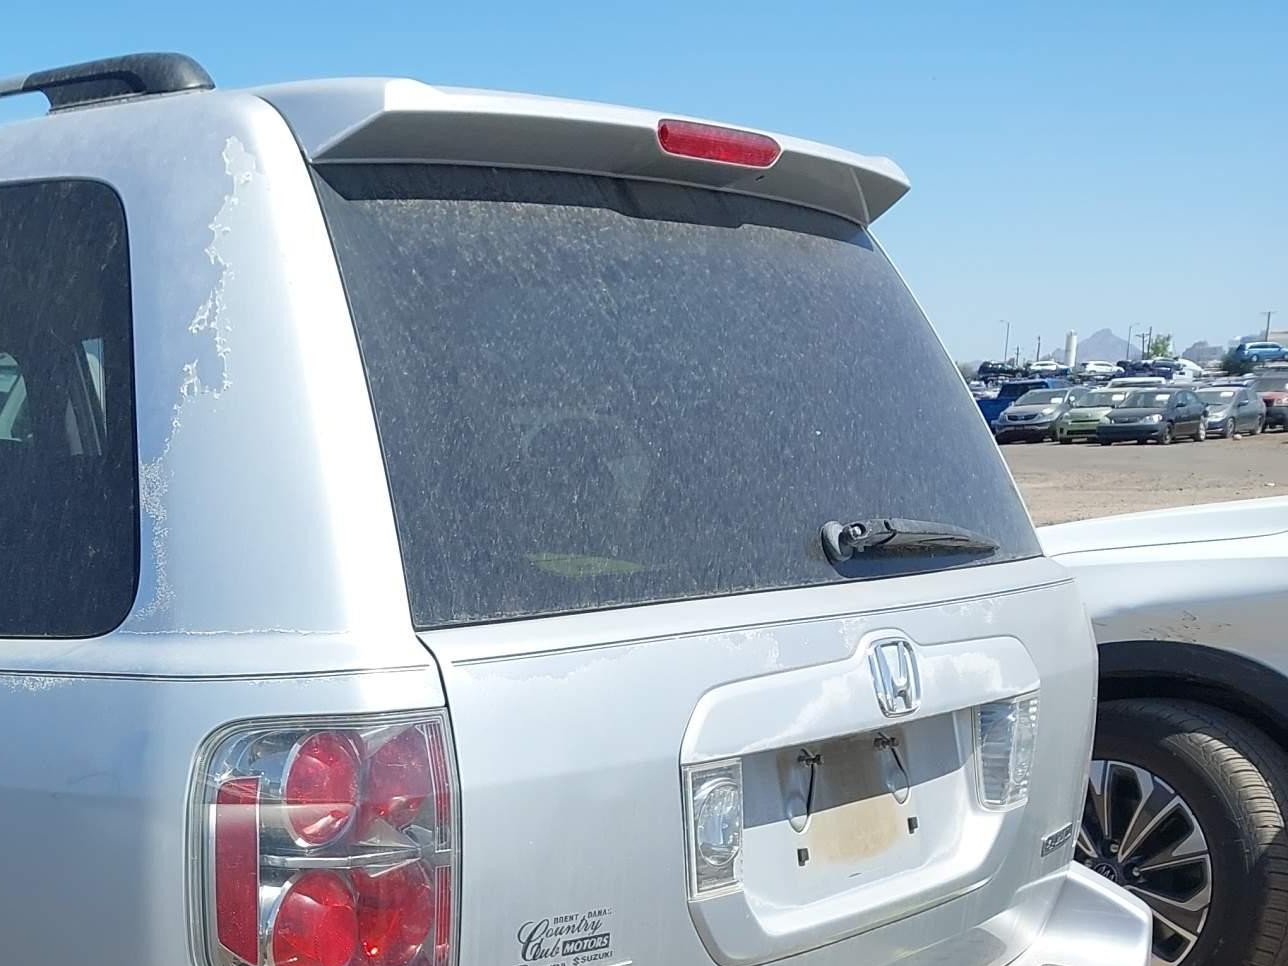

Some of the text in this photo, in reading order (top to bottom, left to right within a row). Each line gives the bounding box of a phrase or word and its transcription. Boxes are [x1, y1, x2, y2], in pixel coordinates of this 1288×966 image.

[517, 915, 603, 944] Country
[521, 936, 610, 962] Club MOTORS
[581, 950, 614, 964] SUZUKI
